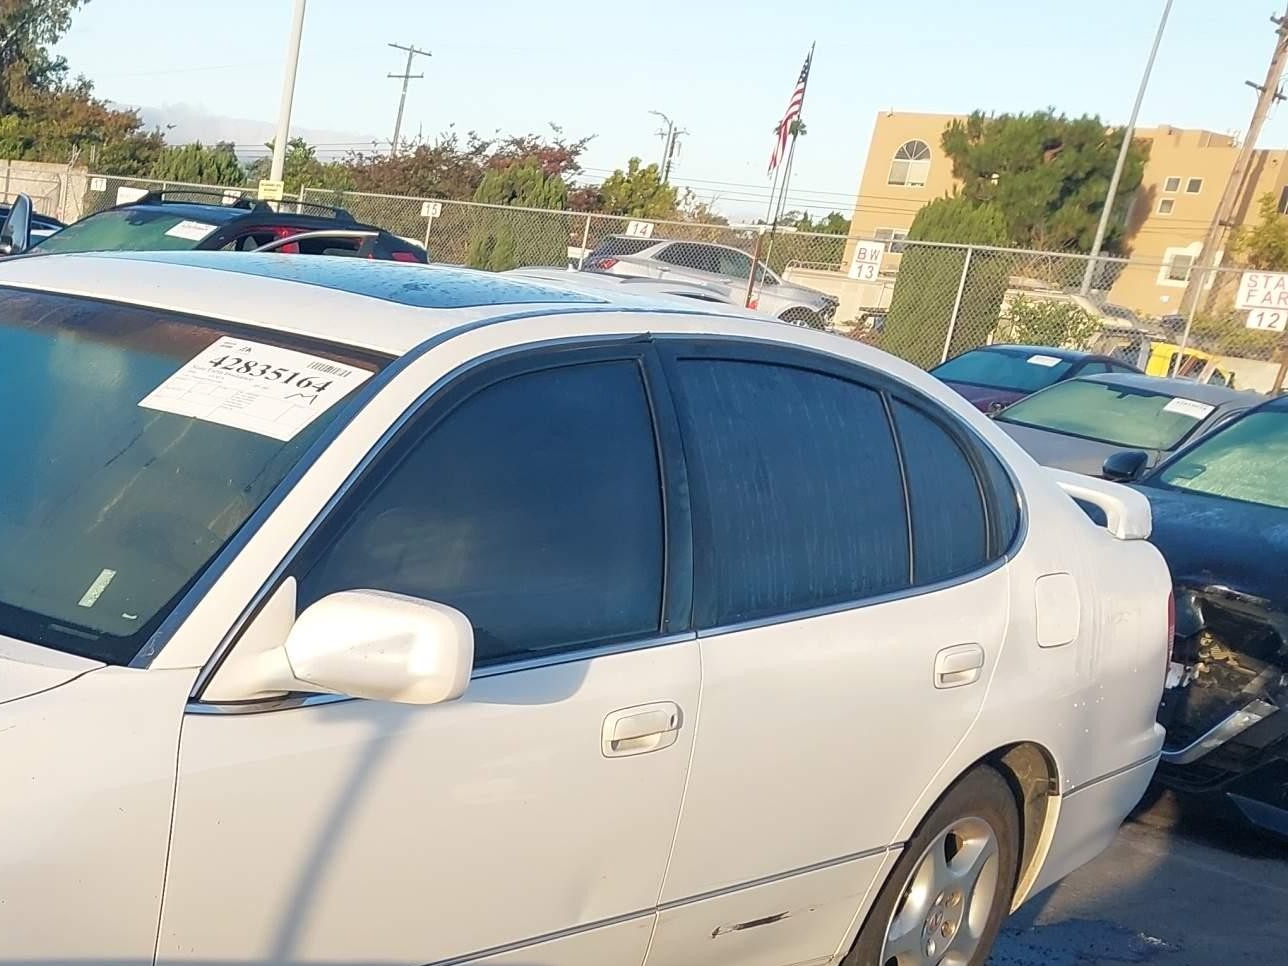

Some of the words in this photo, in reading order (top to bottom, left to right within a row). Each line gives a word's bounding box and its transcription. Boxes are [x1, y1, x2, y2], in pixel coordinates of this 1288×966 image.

[94, 177, 104, 189] 17
[426, 203, 437, 215] 15
[633, 223, 648, 236] 14
[857, 264, 874, 279] 13
[1256, 312, 1280, 329] 12
[208, 355, 333, 393] 42835164
